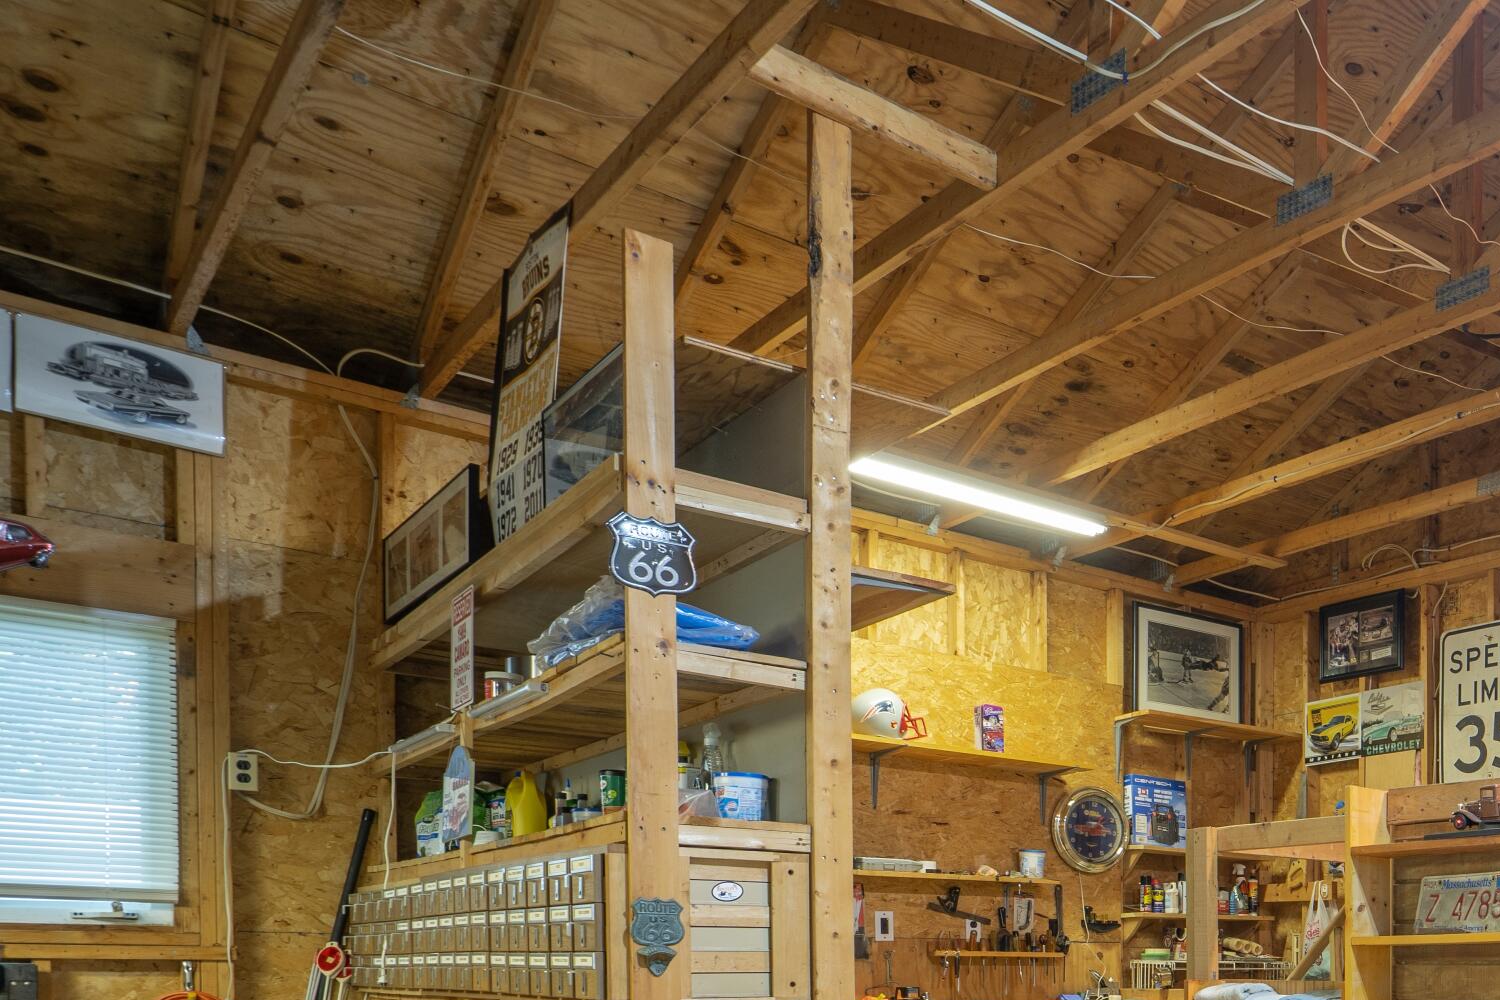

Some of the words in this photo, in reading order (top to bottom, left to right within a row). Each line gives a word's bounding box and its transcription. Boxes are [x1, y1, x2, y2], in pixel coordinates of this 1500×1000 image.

[522, 255, 549, 300] BRUINS
[497, 439, 518, 476] 1929
[497, 472, 515, 509] 1941
[523, 451, 542, 490] 1970
[497, 506, 516, 543] 1972
[525, 487, 543, 523] 2011
[629, 551, 679, 587] 66
[1366, 739, 1421, 755] CHEVROLET
[1441, 877, 1492, 890] Massachusetts
[639, 902, 677, 913] ROUTE
[650, 914, 669, 923] US
[1425, 894, 1440, 922] Z
[641, 922, 674, 943] 66
